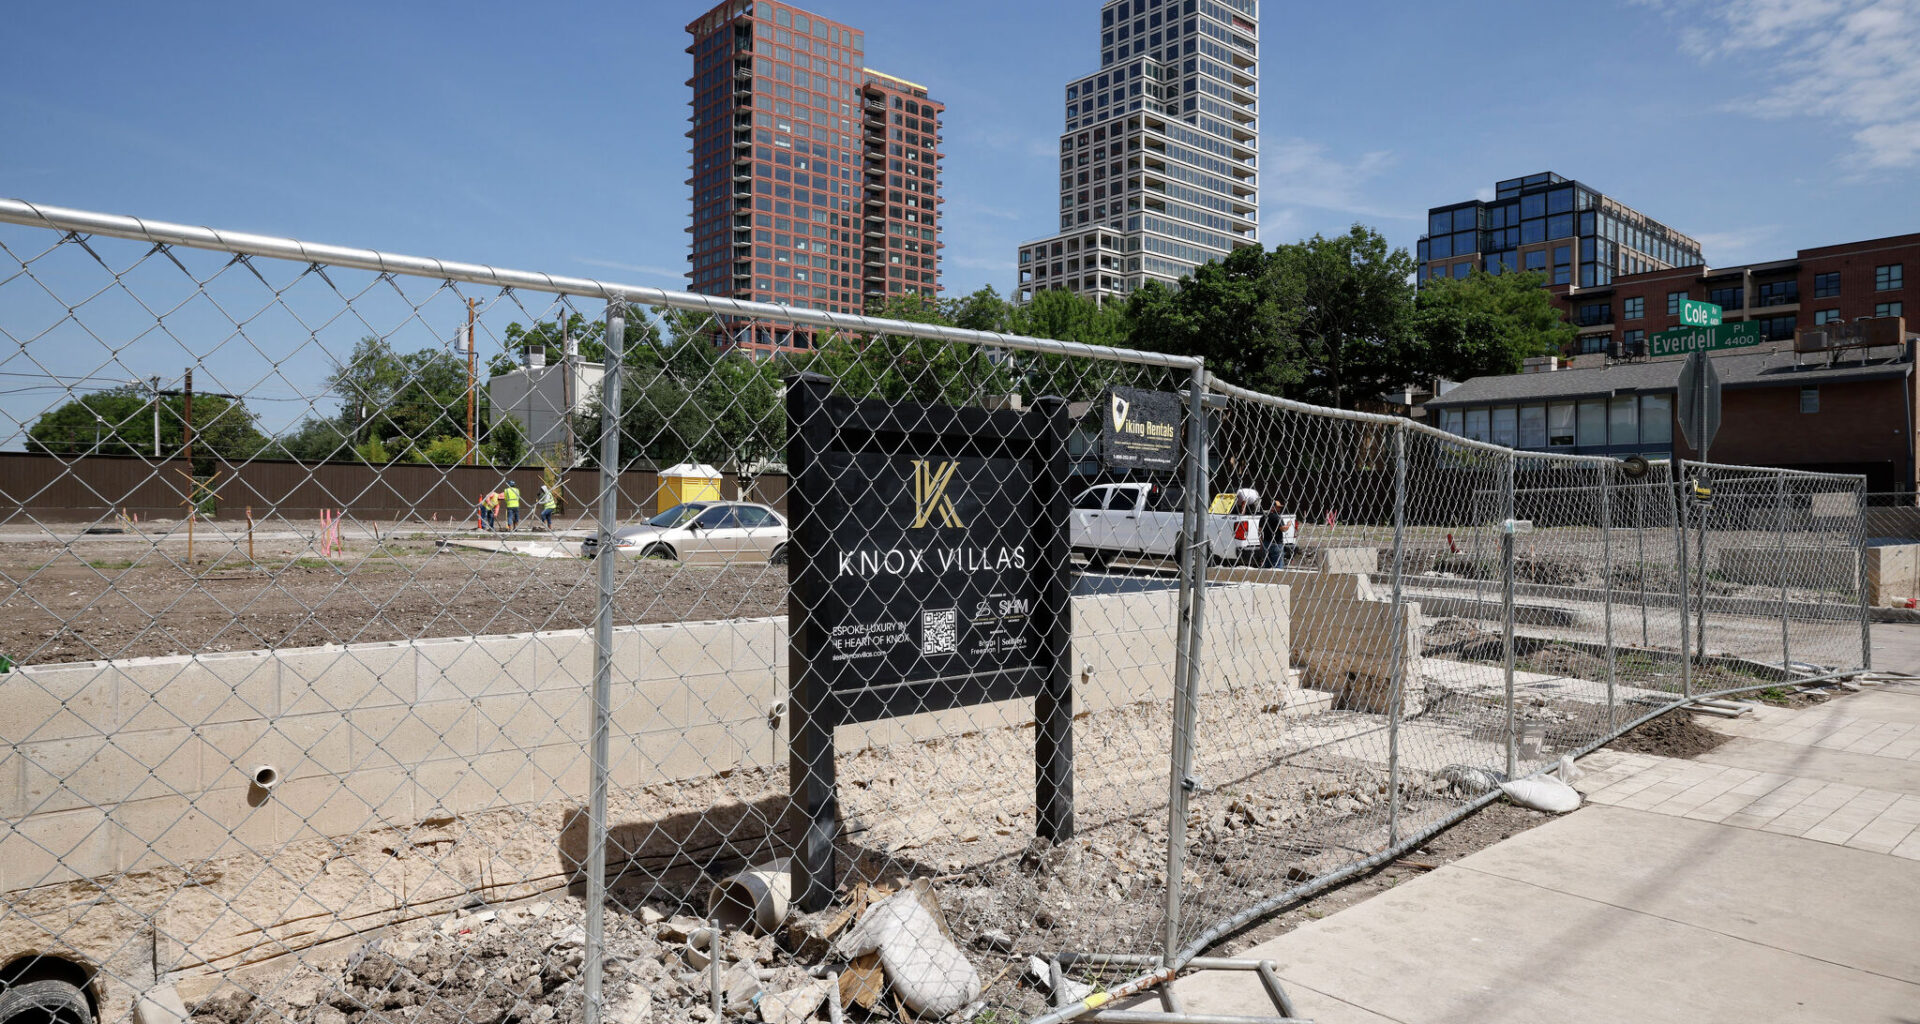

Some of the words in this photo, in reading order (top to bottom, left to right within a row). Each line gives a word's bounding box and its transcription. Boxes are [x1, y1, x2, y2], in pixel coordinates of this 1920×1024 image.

[1684, 303, 1708, 324] Cole
[1653, 328, 1716, 354] Everdell
[1725, 335, 1754, 346] 4400
[1146, 421, 1174, 438] Rentals
[839, 549, 924, 576] KNOX
[938, 546, 1026, 571] VILLAS
[832, 625, 864, 636] ESPOKE
[844, 637, 870, 648] HEART
[872, 636, 884, 645] OF
[886, 633, 910, 644] KNOX
